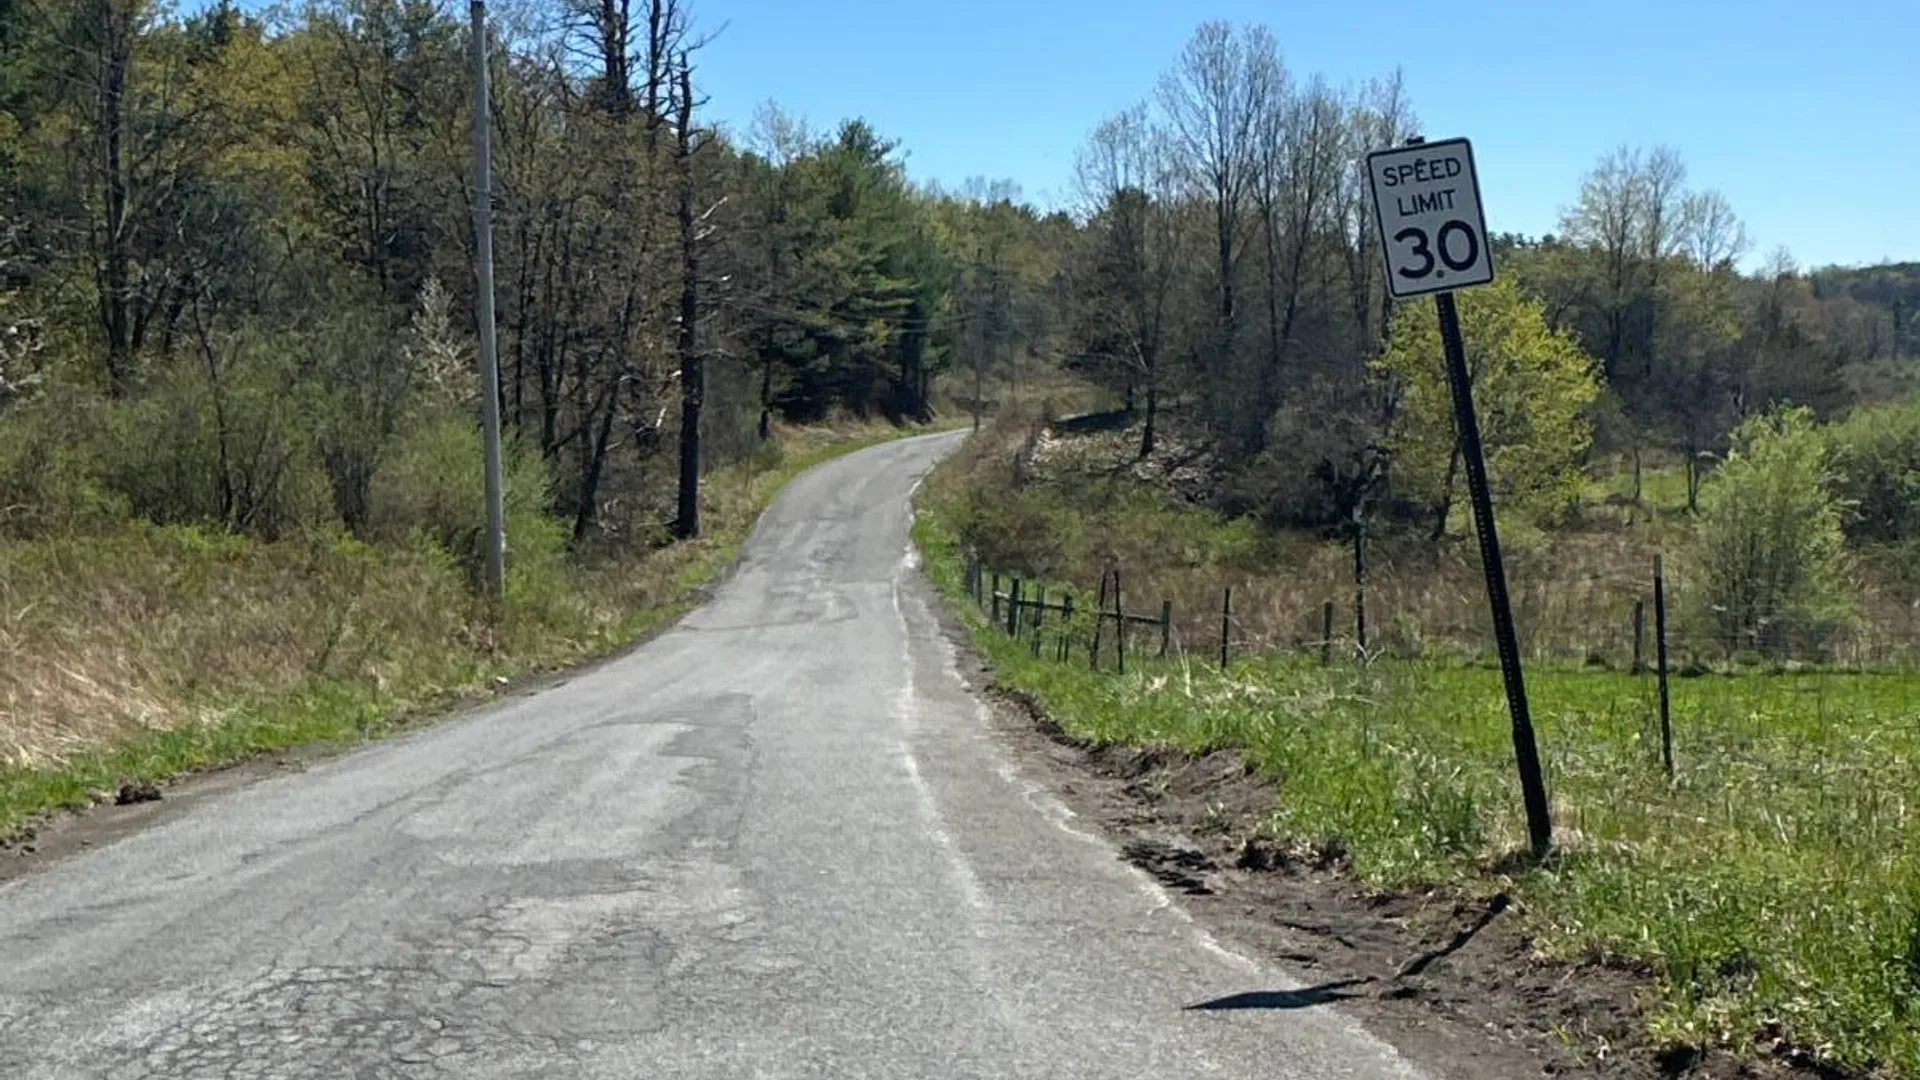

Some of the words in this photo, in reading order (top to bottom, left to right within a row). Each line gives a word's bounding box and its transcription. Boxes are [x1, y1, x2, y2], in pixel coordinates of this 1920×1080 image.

[1383, 157, 1461, 187] SPEED
[1397, 189, 1456, 216] LIMIT
[1394, 220, 1479, 279] 30
